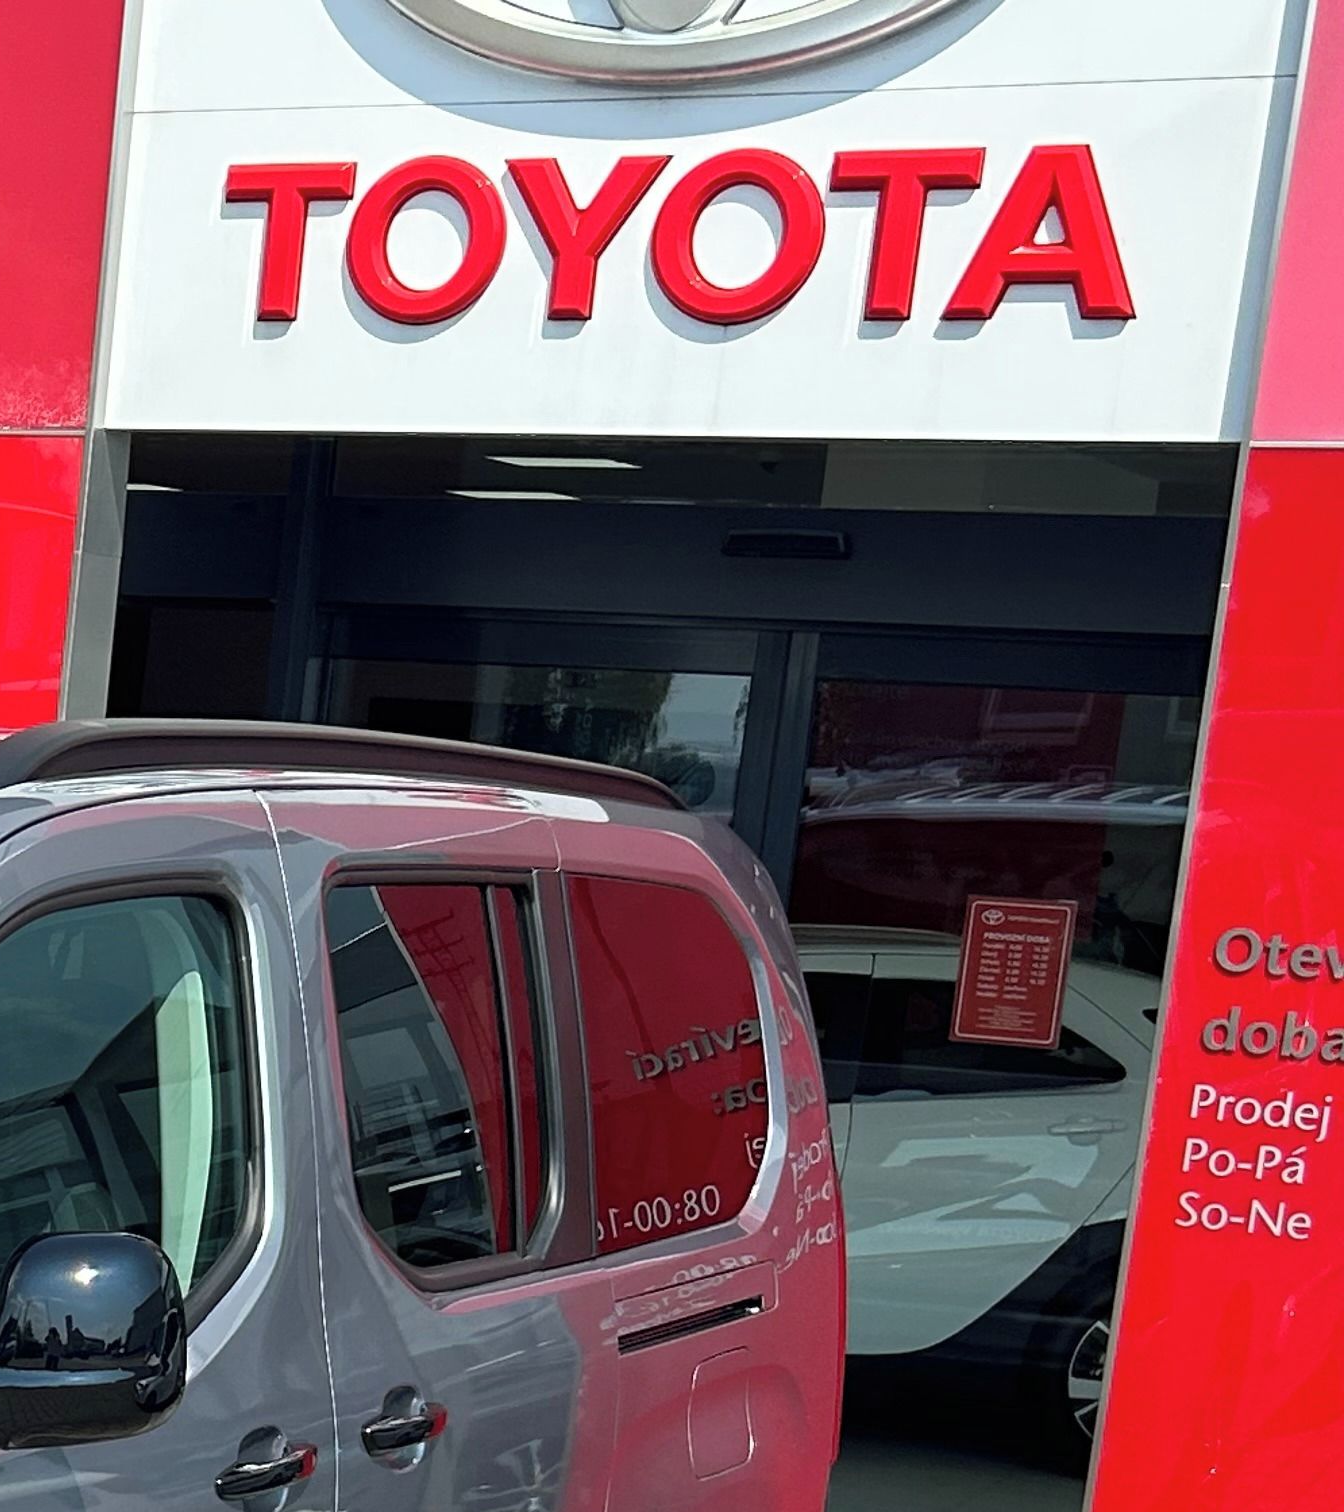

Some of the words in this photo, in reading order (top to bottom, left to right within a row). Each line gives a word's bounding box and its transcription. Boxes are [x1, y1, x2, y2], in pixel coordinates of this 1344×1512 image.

[225, 144, 1137, 326] TOYOTA
[1202, 1006, 1344, 1063] doba
[1190, 1083, 1333, 1142] Prodej
[1182, 1137, 1308, 1184] Po-Pá
[1175, 1191, 1312, 1240] So-Ne
